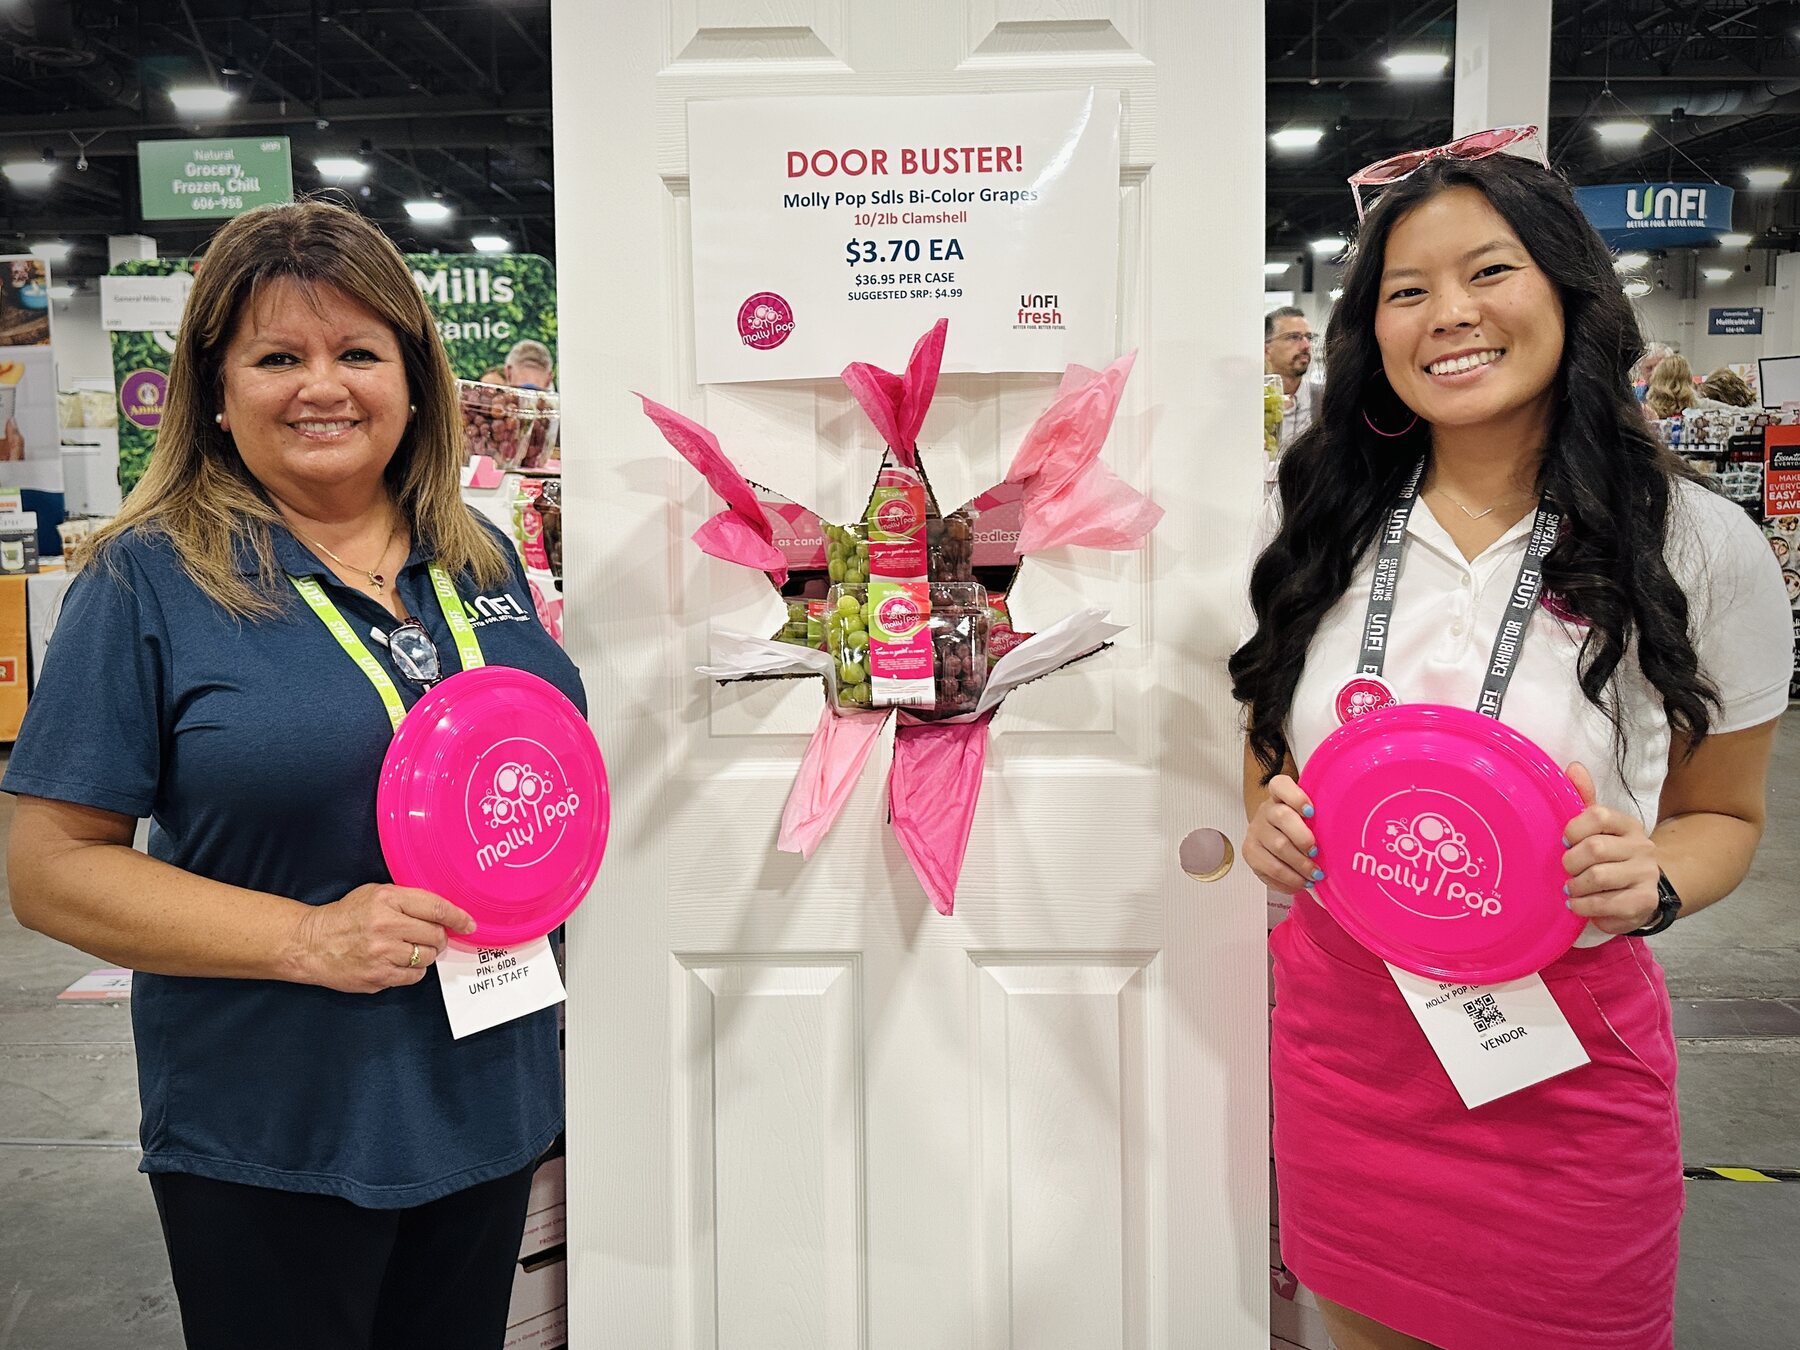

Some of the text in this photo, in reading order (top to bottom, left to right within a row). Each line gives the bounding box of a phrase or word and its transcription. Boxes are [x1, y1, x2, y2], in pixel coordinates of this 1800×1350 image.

[194, 148, 235, 160] Natural
[787, 145, 1023, 178] DOOR BUSTER!
[185, 161, 244, 178] Grocery,
[173, 176, 260, 195] Frozen, Chill
[784, 187, 1038, 209] Molly Pop Sdls Bi-Color Grapes
[1626, 186, 1706, 219] UNFI
[854, 211, 967, 227] 10/2lb Clamshell
[846, 238, 964, 267] $3.70 EA
[412, 267, 514, 304] Mills
[855, 272, 955, 287] $36.95 PER CASE
[848, 288, 963, 301] SUGGESTED SRP: $4.99
[1021, 294, 1058, 308] UNFI
[1018, 308, 1062, 324] fresh
[435, 316, 510, 342] anic
[1769, 490, 1796, 501] EASY
[974, 530, 1020, 542] eedless
[1387, 508, 1408, 544] UNFI
[1528, 511, 1547, 556] CELEBRATING
[1541, 513, 1560, 545] YEARS
[793, 537, 823, 546] cand
[1378, 558, 1389, 570] 50
[1372, 571, 1387, 601] YEARS
[1384, 558, 1398, 601] CELEBRATING
[1512, 569, 1539, 609] UNFI
[330, 620, 355, 645] STAFF
[1368, 614, 1387, 651] UNFI
[1491, 620, 1523, 677] EXHIBITOR
[361, 656, 391, 687] UNFI
[1479, 690, 1498, 717] NFI
[469, 966, 529, 995] UNFI STAFF
[476, 964, 495, 977] PIN:
[1425, 985, 1468, 1009] MOLLY POP
[1480, 1026, 1528, 1051] VENDOR
